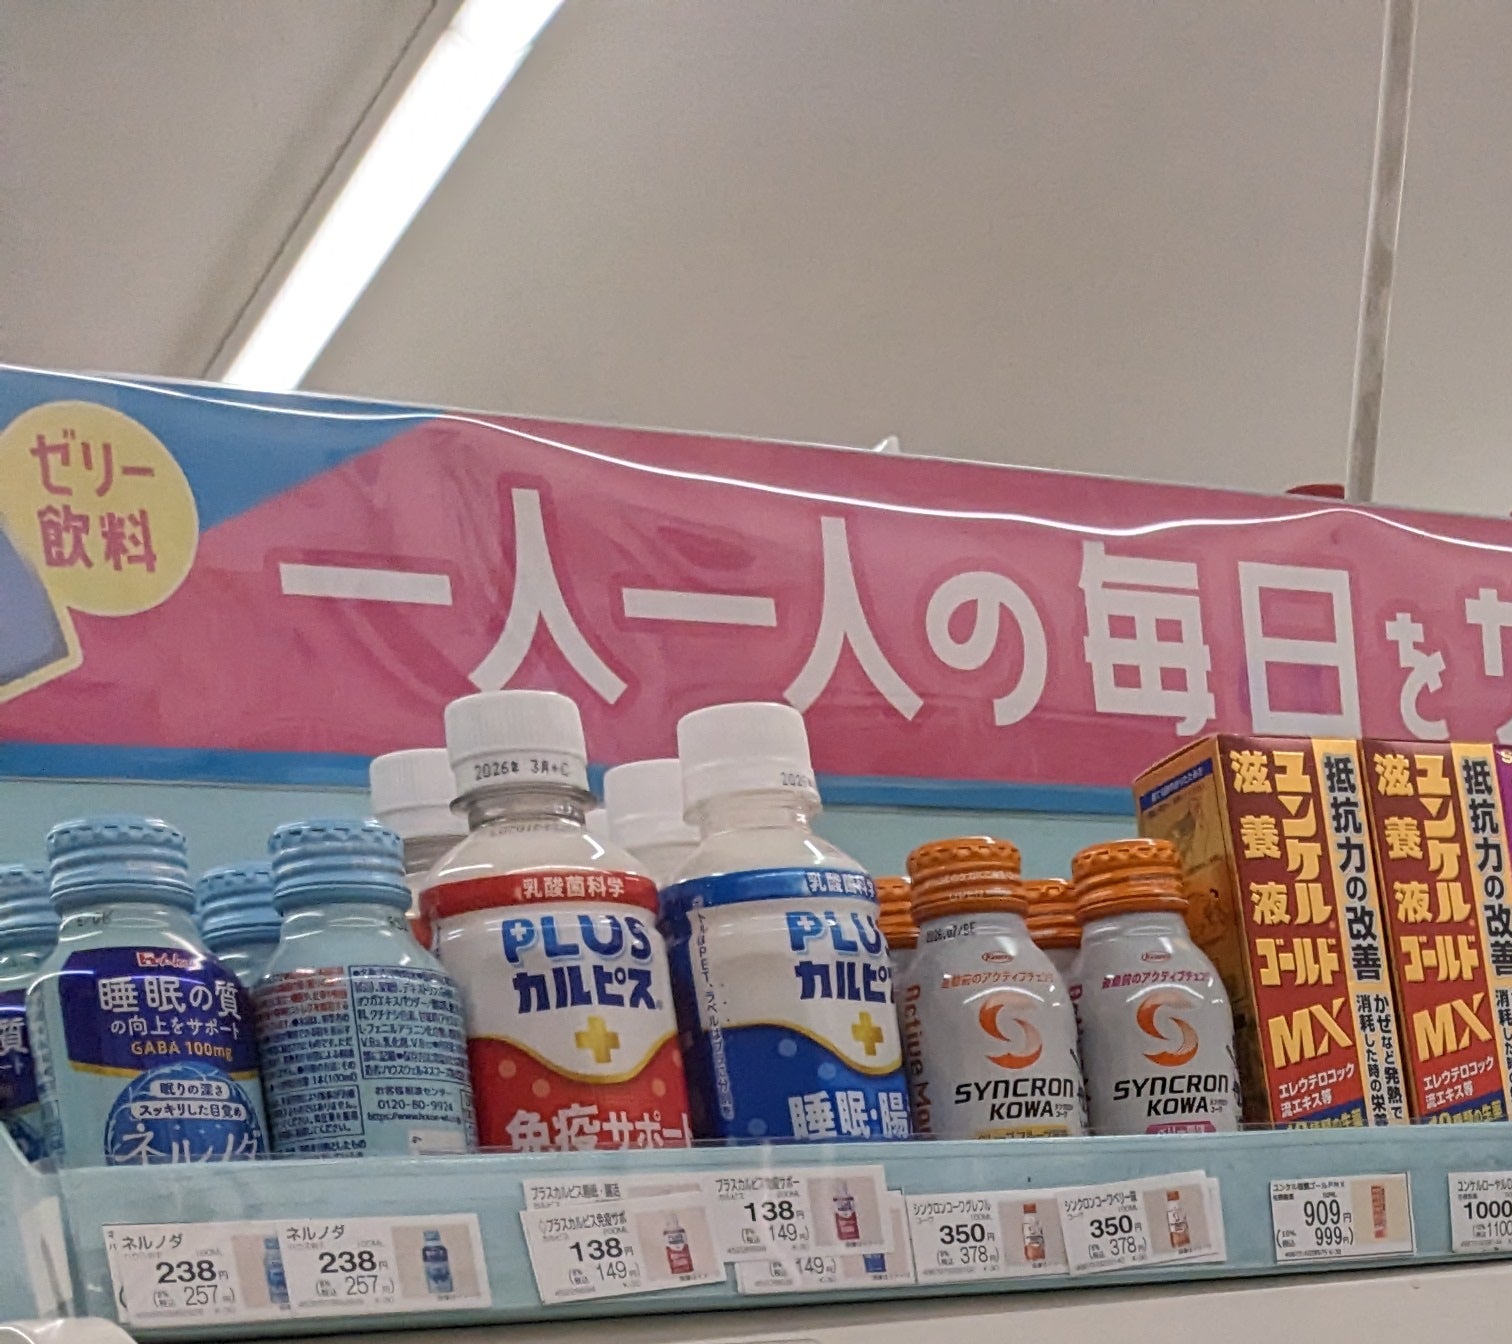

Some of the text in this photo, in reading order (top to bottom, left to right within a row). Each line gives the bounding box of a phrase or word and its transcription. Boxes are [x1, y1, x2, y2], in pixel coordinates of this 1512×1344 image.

[30, 429, 156, 498] ゼリー
[39, 505, 157, 572] 飲料
[500, 914, 654, 965] PLUS
[99, 976, 243, 1020] 睡眠の質
[109, 1016, 241, 1040] の向上をサポート
[130, 1040, 233, 1062] GABA 100mg
[1268, 998, 1354, 1068] MX
[1412, 994, 1492, 1061] MX
[989, 1098, 1054, 1121] KOWA
[1147, 1095, 1209, 1117] KOWA
